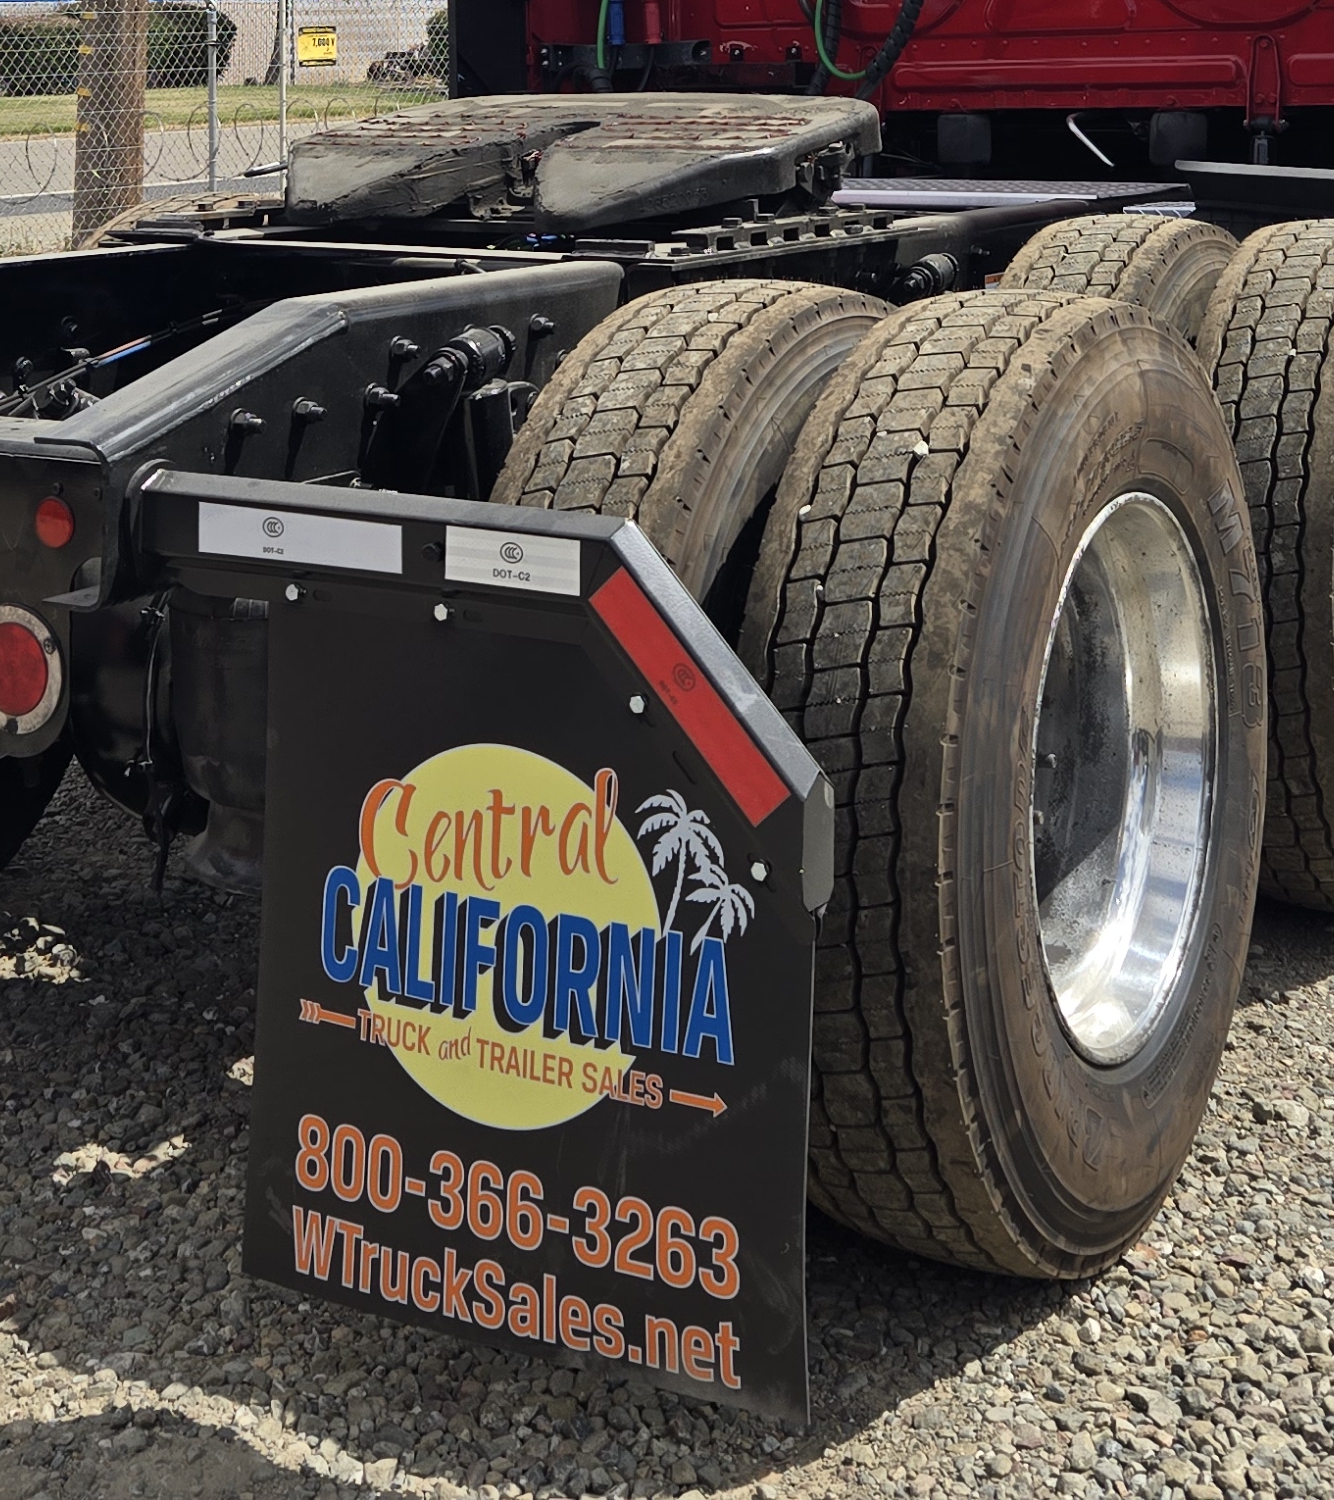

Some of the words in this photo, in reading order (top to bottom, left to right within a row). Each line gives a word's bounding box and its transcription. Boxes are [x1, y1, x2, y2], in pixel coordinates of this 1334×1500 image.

[492, 568, 531, 583] DOT-C2
[359, 766, 619, 892] Central
[320, 864, 735, 1067] CALIFORNIA
[357, 1008, 432, 1056] TRUCK
[438, 1026, 472, 1061] and
[475, 1037, 574, 1089] TRAILER
[581, 1061, 664, 1110] SALES
[294, 1112, 742, 1300] 800-366-3263
[291, 1204, 743, 1390] WTruckSales.net
